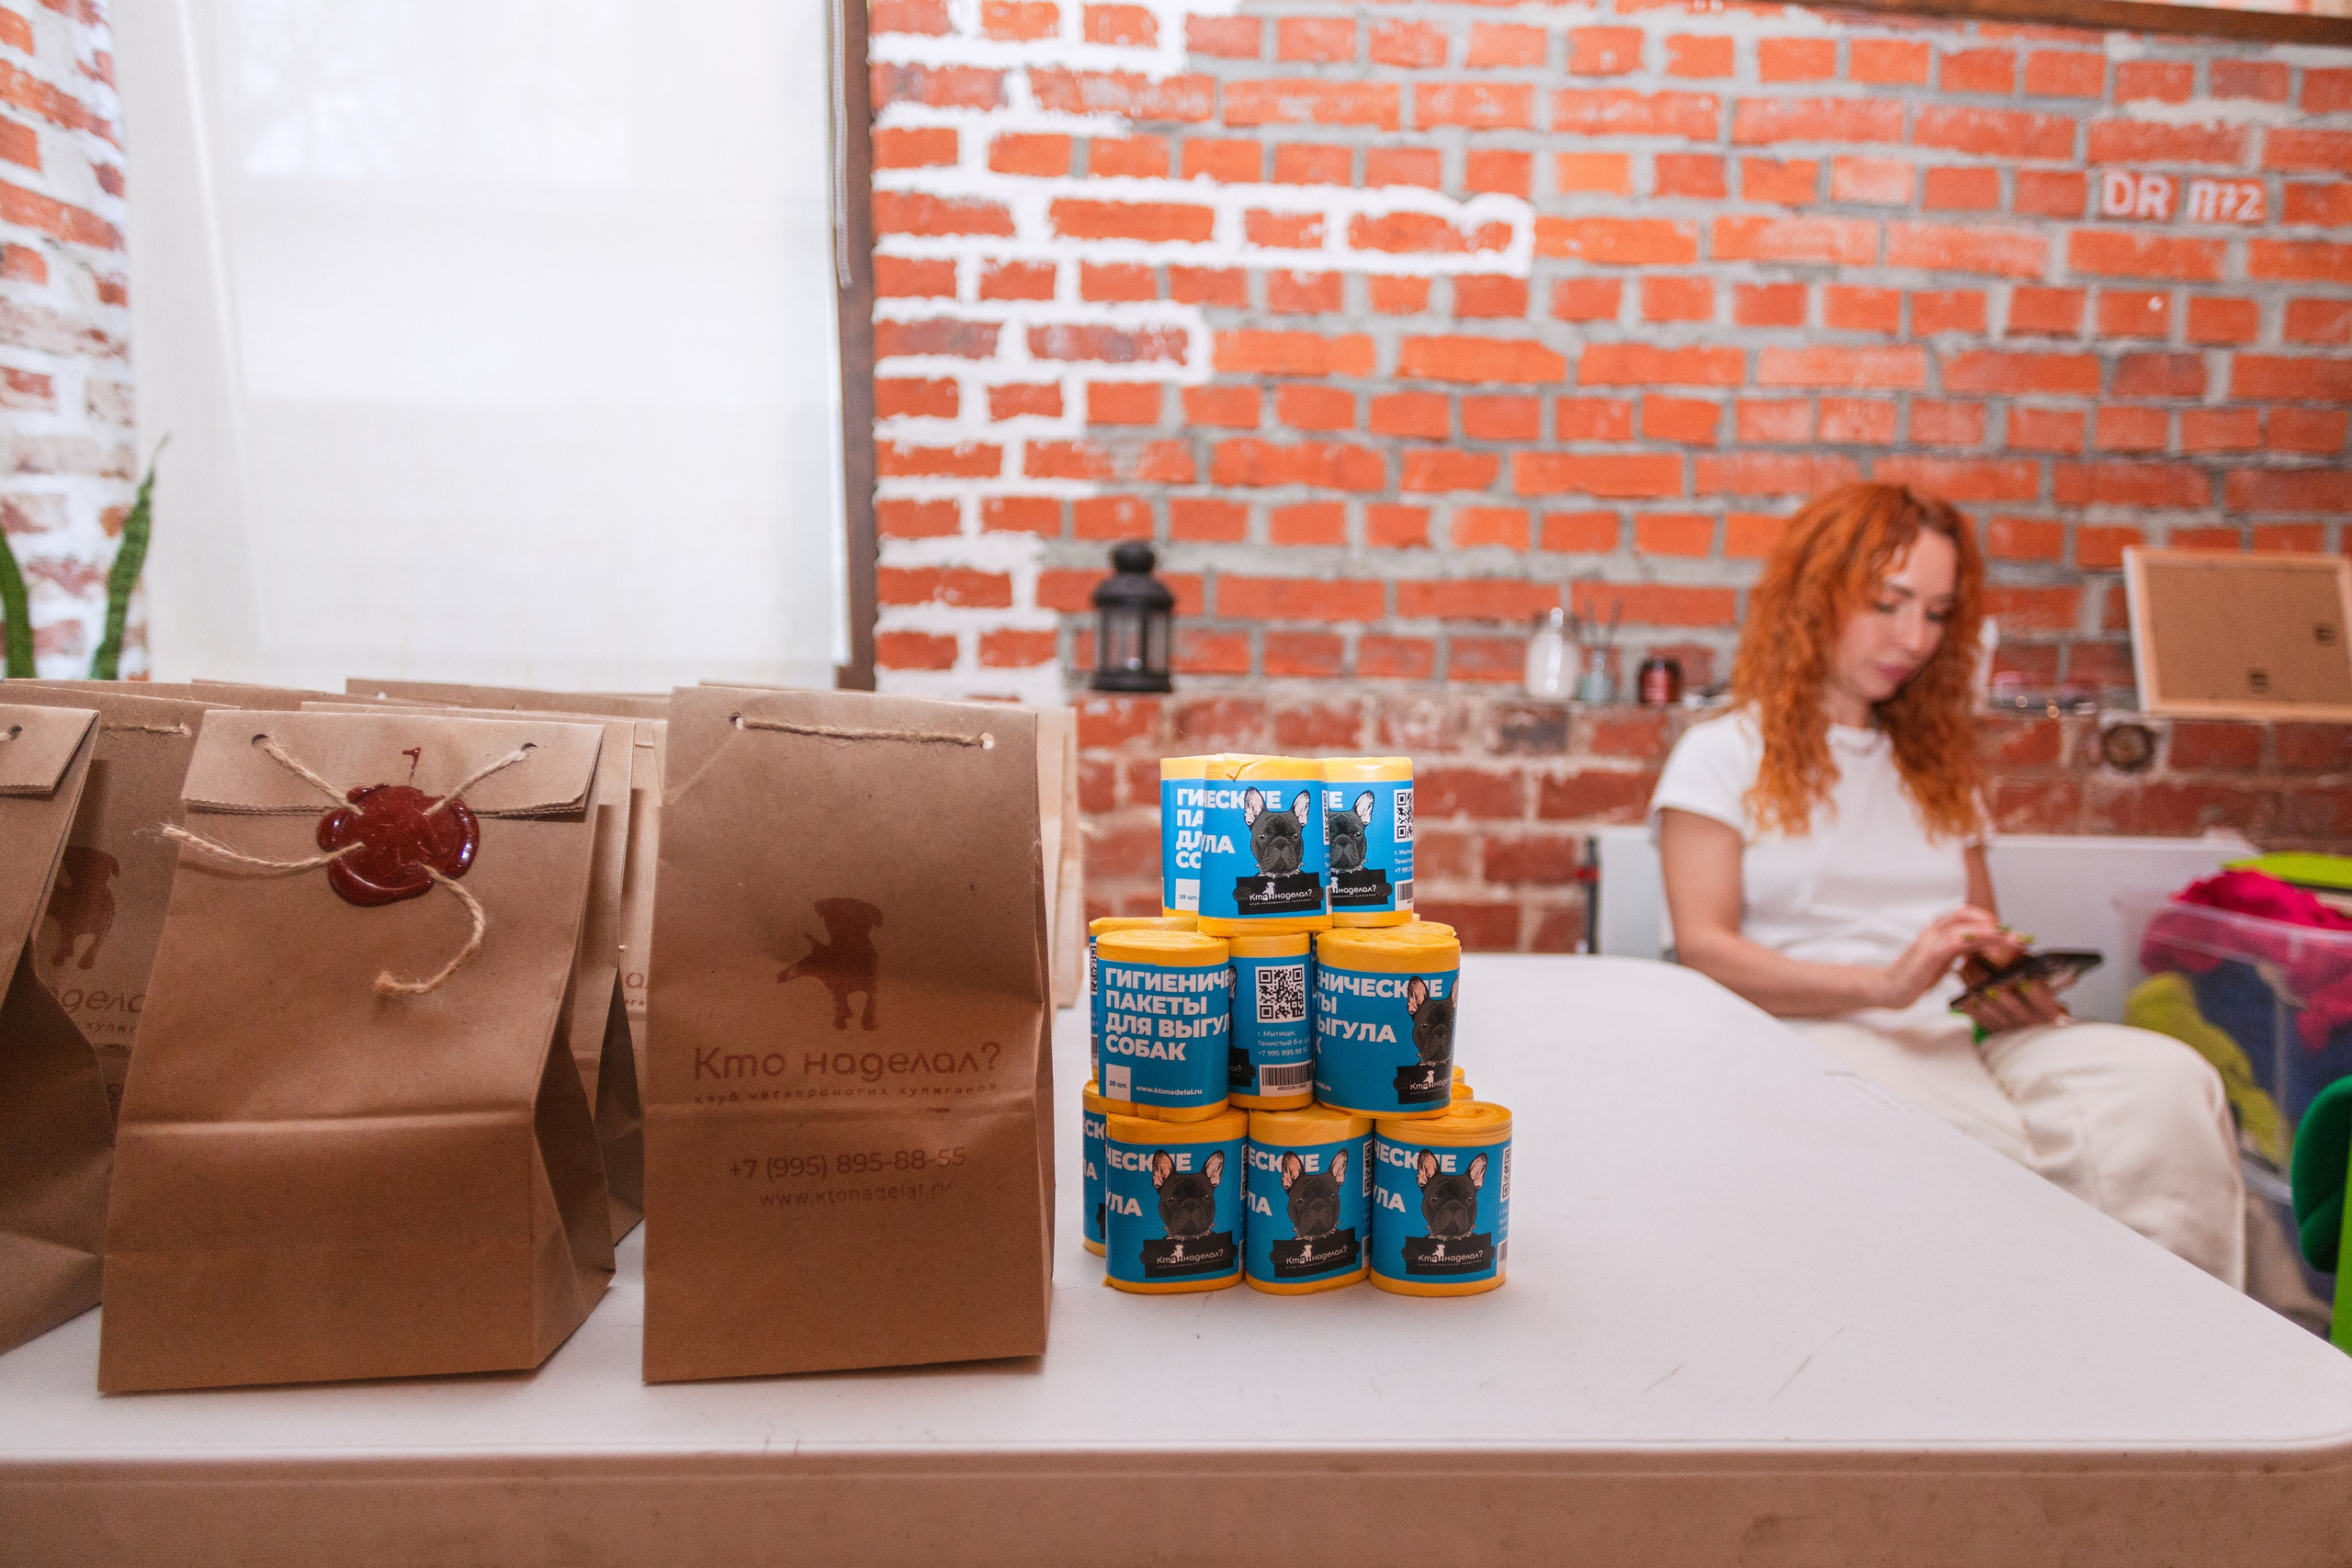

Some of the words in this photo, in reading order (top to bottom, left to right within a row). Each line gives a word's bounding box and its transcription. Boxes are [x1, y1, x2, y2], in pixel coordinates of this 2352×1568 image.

[2103, 172, 2170, 218] DR
[1274, 888, 1313, 901] наделал?
[1105, 989, 1207, 1016] ПАКЕТЫ
[1105, 1012, 1152, 1036] ДЛЯ
[1316, 1013, 1397, 1043] ЫГУЛА
[1105, 1034, 1187, 1061] СОБАК
[694, 1046, 786, 1080] Кто
[803, 1042, 1001, 1083] наделал?
[694, 1090, 740, 1105] клуб
[749, 1086, 888, 1102] четвероногих
[1136, 1085, 1203, 1096] www.ktonadelal.ru
[729, 1157, 758, 1179] +7
[766, 1153, 828, 1183] (995)
[835, 1147, 967, 1175] 895-88-55
[1183, 1248, 1224, 1263] наделал?
[1312, 1246, 1348, 1261] наделал?
[1444, 1249, 1484, 1264] наделал?
